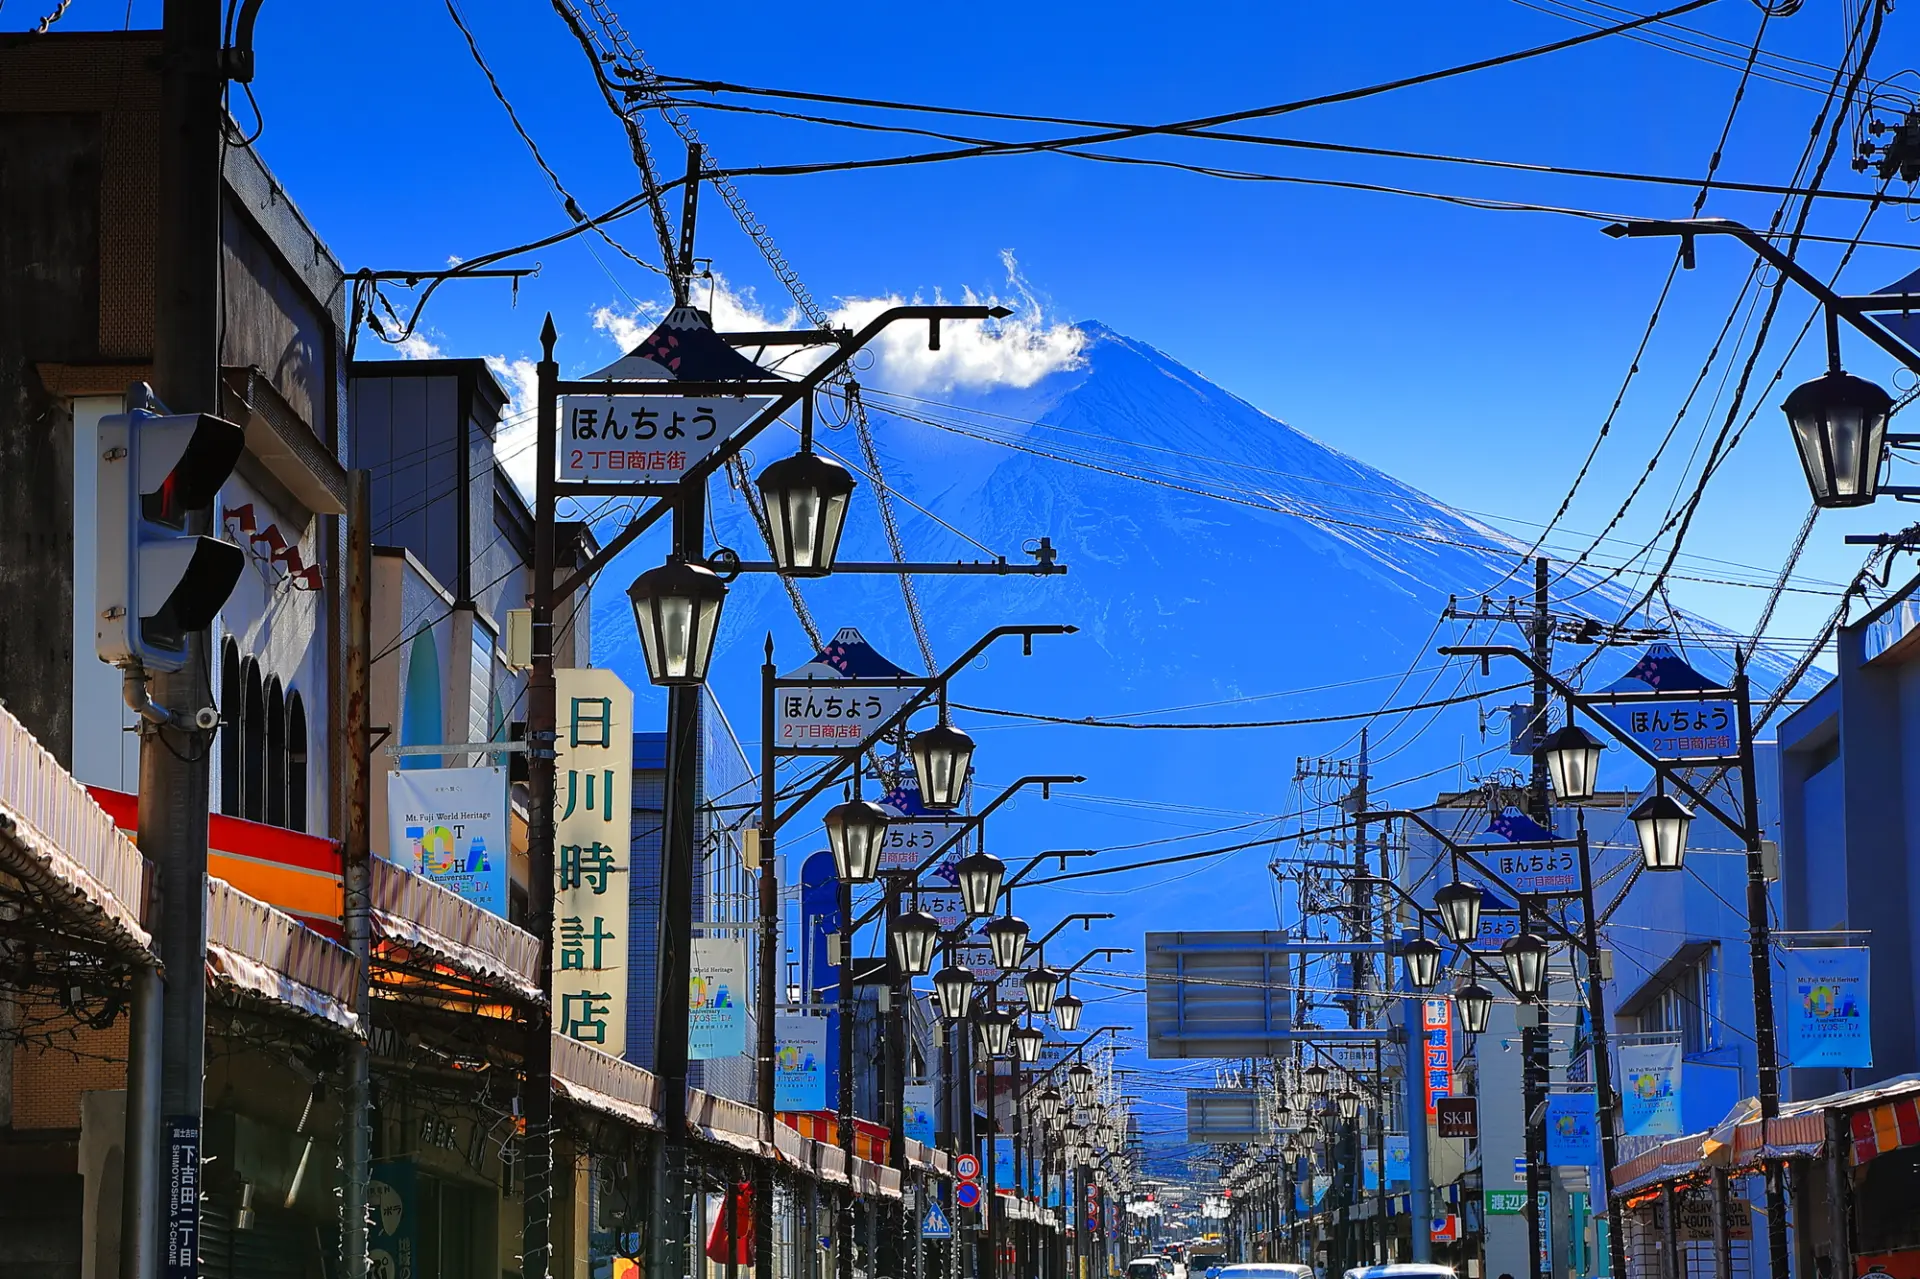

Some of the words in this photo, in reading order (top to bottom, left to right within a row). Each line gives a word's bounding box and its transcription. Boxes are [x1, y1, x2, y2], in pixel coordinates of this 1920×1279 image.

[571, 406, 718, 441] ほんちょう
[784, 695, 883, 719] ほんちょう
[1632, 707, 1729, 733] ほんちょう
[405, 814, 418, 822] Mt.
[420, 813, 434, 823] Fuji
[436, 812, 459, 820] World
[460, 812, 491, 820] Heritage
[883, 829, 934, 848] ちょう
[560, 697, 617, 1045] 日川時計店
[1500, 852, 1573, 874] ほんちょう
[429, 874, 475, 883] Anniversary
[957, 953, 996, 966] ほんちょ
[1443, 1111, 1472, 1125] SK-II
[960, 1161, 974, 1173] 40
[170, 1144, 180, 1217] SHIMOYOSHIDA
[178, 1145, 196, 1267] 下吉田二丁目
[168, 1221, 179, 1266] 2-CHOME
